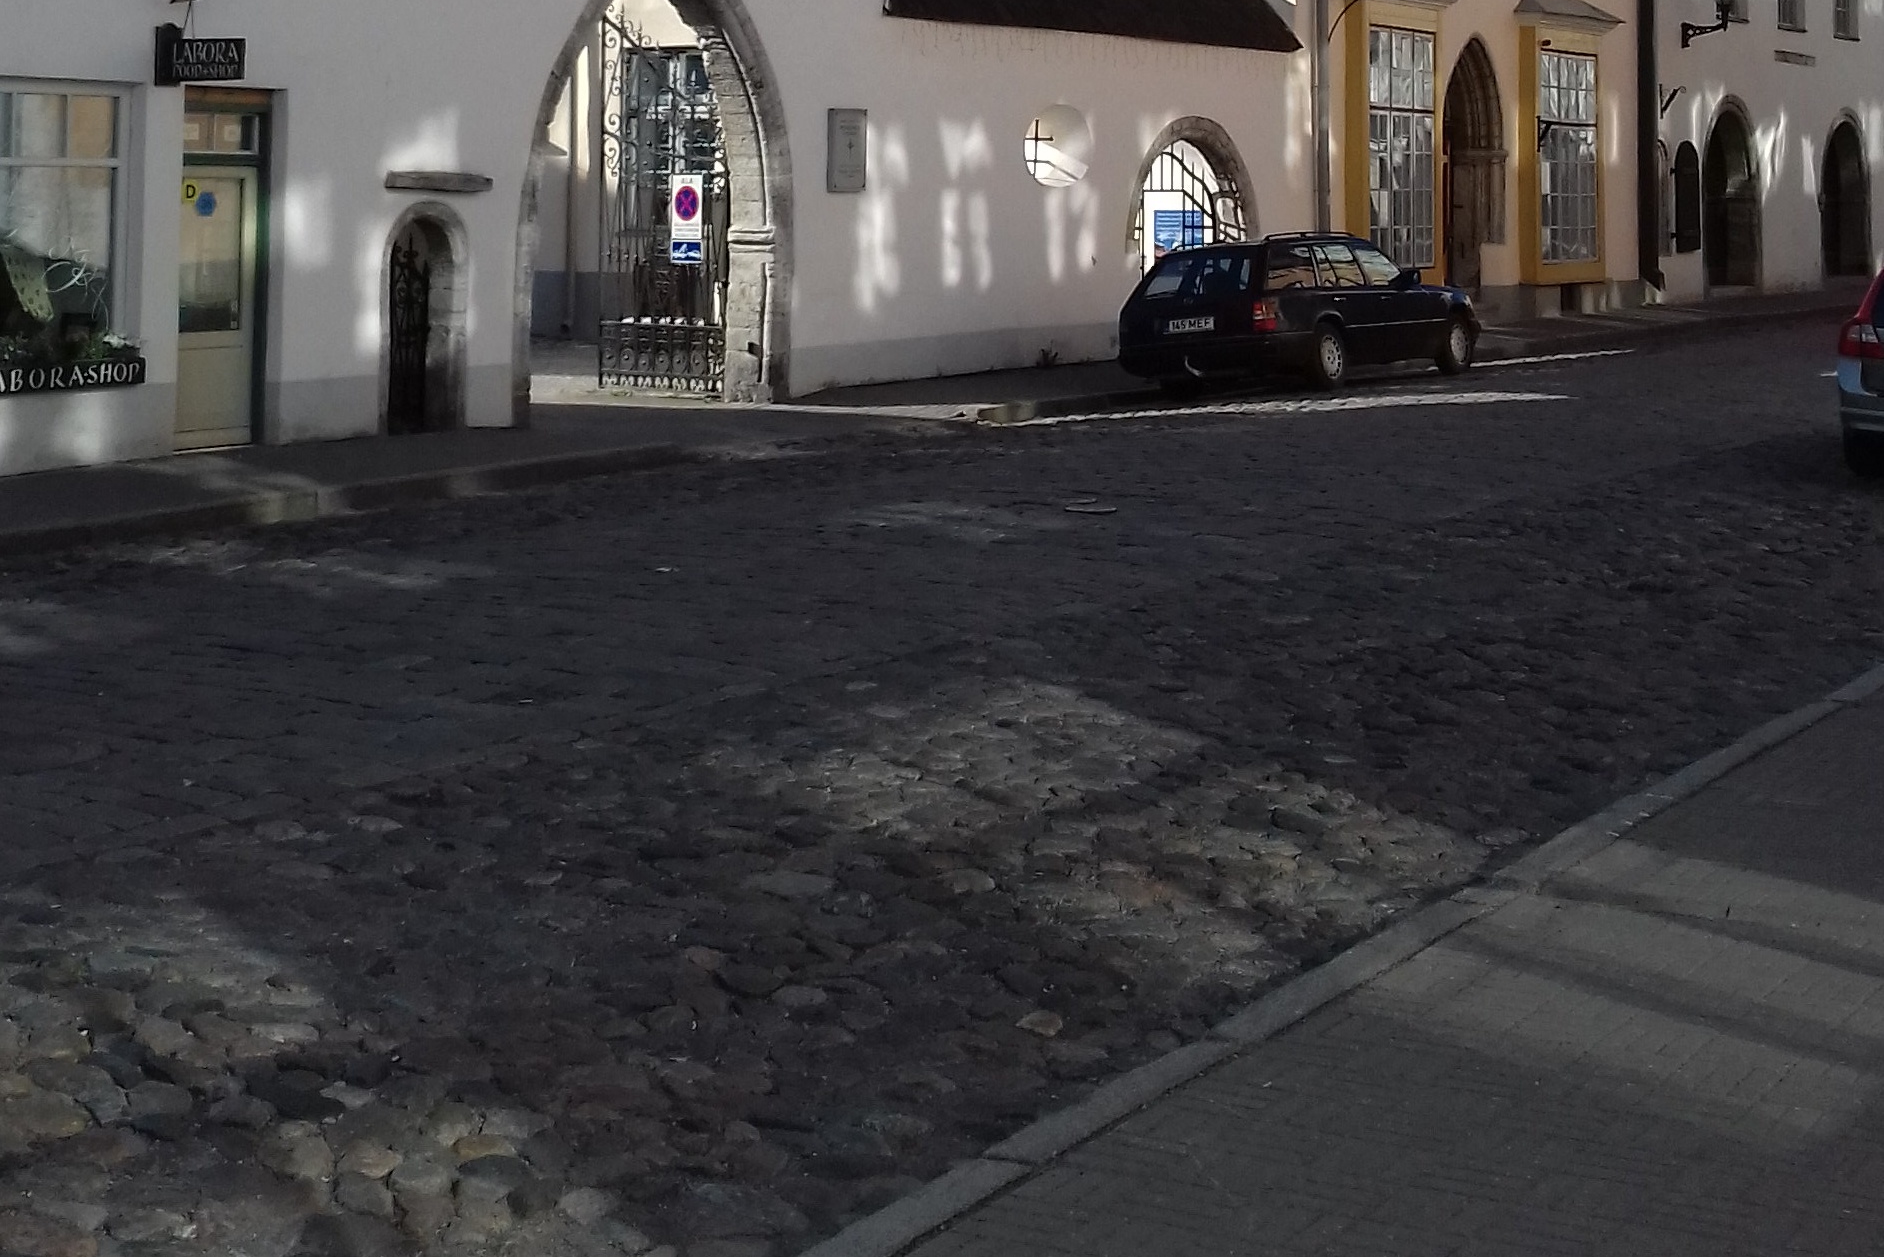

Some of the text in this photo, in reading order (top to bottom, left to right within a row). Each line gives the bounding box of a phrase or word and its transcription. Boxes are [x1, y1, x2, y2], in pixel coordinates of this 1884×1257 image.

[173, 42, 239, 63] LABORA
[186, 184, 196, 198] D
[1188, 318, 1210, 329] MEF
